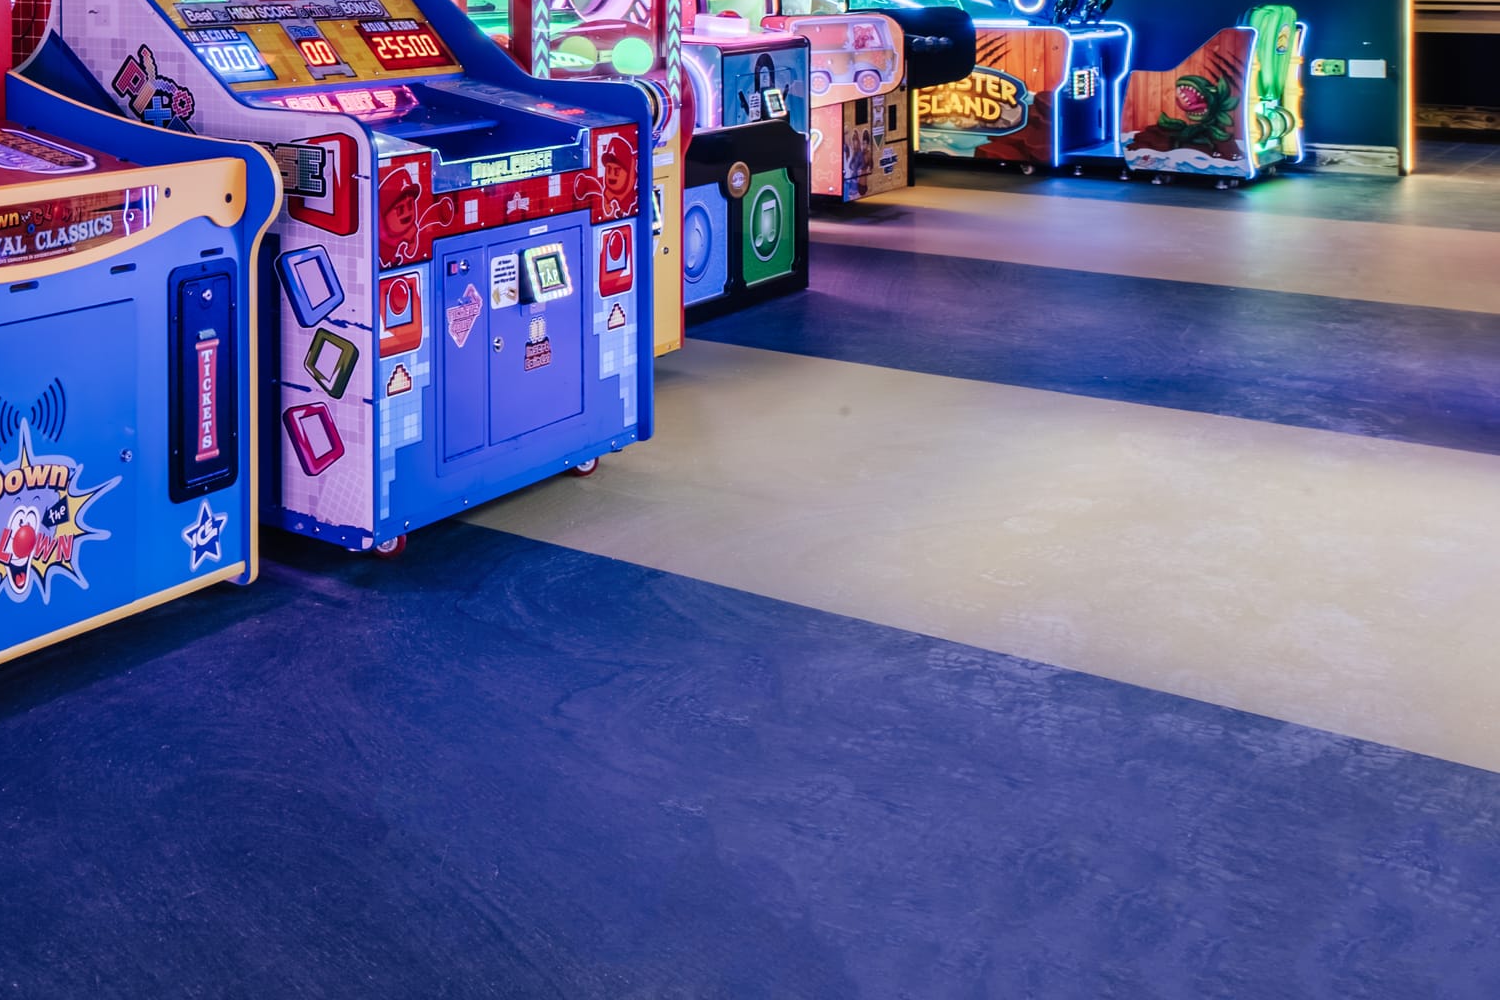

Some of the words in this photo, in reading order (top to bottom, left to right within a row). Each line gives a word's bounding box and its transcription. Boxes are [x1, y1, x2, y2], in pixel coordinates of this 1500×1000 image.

[183, 9, 217, 22] Beat
[227, 6, 258, 21] HIGH
[257, 4, 297, 20] SCORE
[339, 1, 381, 15] BONUS
[197, 44, 261, 71] 000
[300, 40, 336, 65] 00
[371, 34, 441, 60] 25500
[34, 213, 115, 252] CLASSICS
[539, 268, 560, 287] TAP
[201, 349, 214, 449] TICKETS
[48, 504, 67, 525] the
[191, 518, 218, 551] ICE
